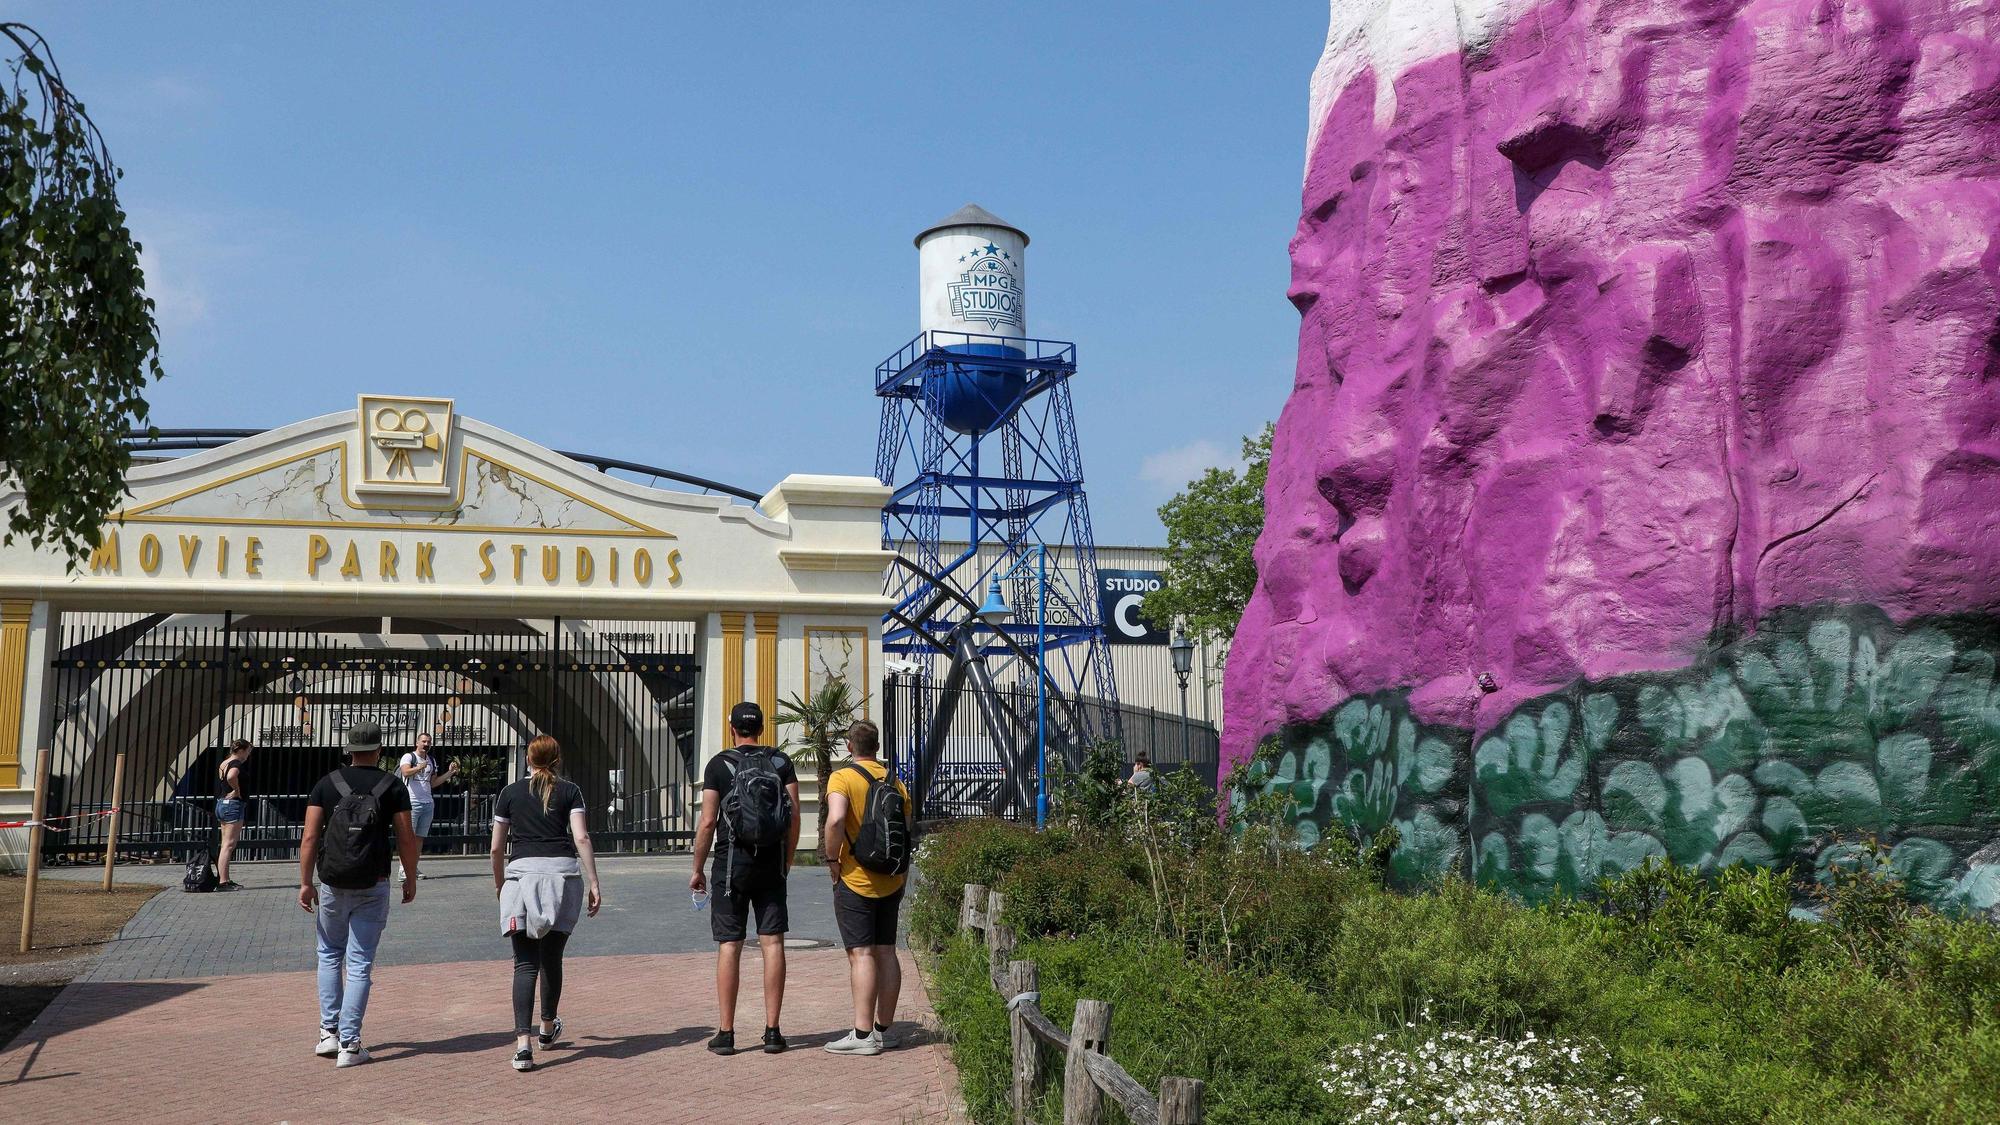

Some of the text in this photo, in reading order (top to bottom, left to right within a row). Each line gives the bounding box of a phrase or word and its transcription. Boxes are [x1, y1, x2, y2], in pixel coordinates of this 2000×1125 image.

[973, 274, 1009, 289] MPG
[962, 291, 1017, 314] STUDIOS
[90, 527, 681, 585] MOVIE PARK STUDIOS
[1105, 577, 1161, 592] STUDIO
[1031, 595, 1060, 607] MG
[1114, 593, 1148, 638] C
